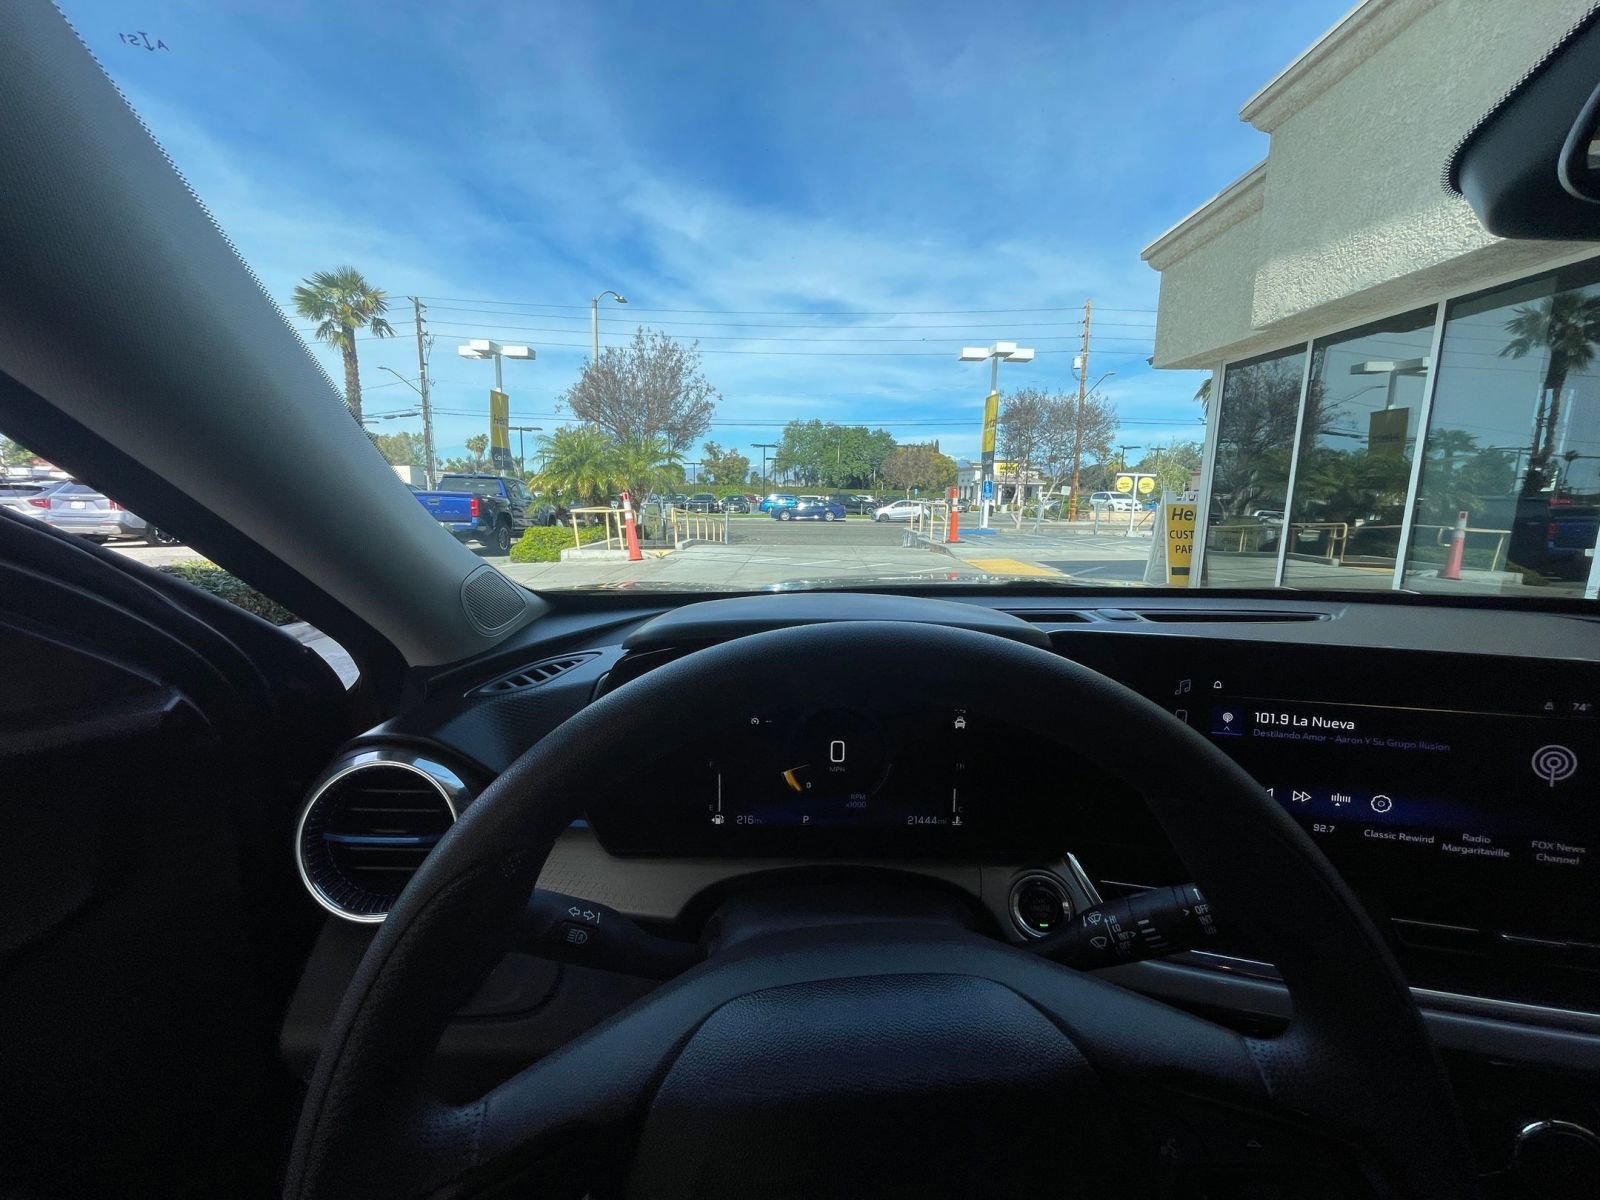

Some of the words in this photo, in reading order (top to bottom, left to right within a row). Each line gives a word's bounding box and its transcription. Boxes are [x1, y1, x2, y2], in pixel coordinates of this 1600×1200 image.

[1254, 712, 1290, 726] 101.9
[1293, 714, 1308, 728] La
[1312, 716, 1356, 731] Nueva
[1253, 728, 1301, 741] Destilando
[1302, 732, 1328, 742] Amor
[1364, 736, 1371, 745] Y
[1373, 738, 1385, 747] Su
[1386, 738, 1417, 751] Grupo
[830, 740, 845, 762] 0
[802, 815, 810, 823] P
[1313, 823, 1336, 833] 92.7
[1364, 828, 1396, 841] Classic
[1399, 832, 1435, 844] Rewind
[1462, 833, 1492, 845] Radio
[1442, 844, 1510, 858] Margaritaville
[1531, 840, 1555, 850] FOX
[1556, 843, 1586, 854] News
[1536, 853, 1580, 865] Channel
[1194, 904, 1209, 914] OFF
